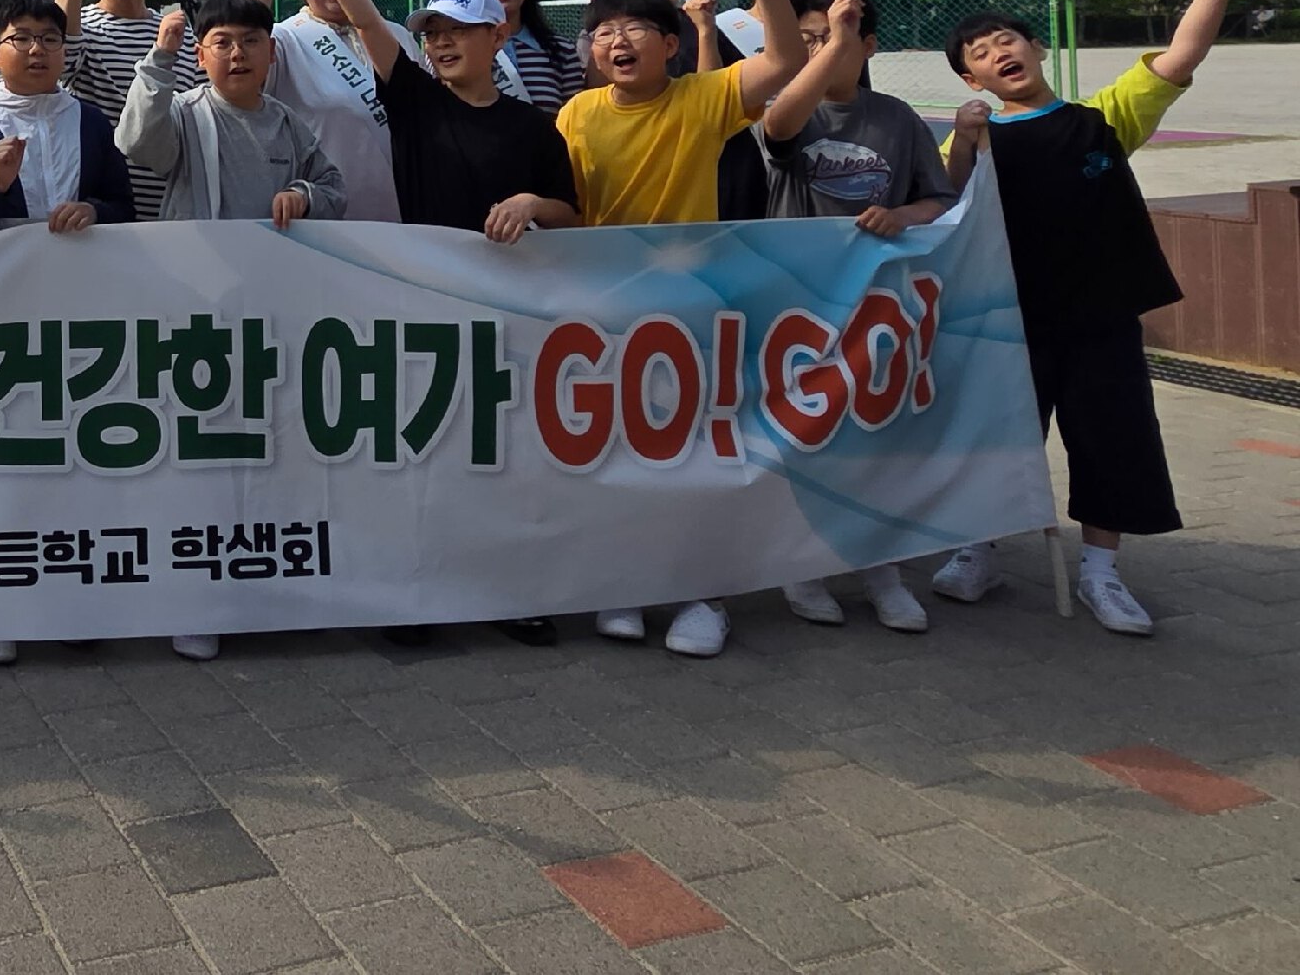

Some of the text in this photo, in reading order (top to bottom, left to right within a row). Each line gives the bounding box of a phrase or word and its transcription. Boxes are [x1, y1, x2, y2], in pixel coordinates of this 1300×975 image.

[301, 317, 512, 465] 여가
[534, 317, 745, 467] GO!
[761, 277, 942, 446] GO!
[171, 521, 332, 581] 학생회
